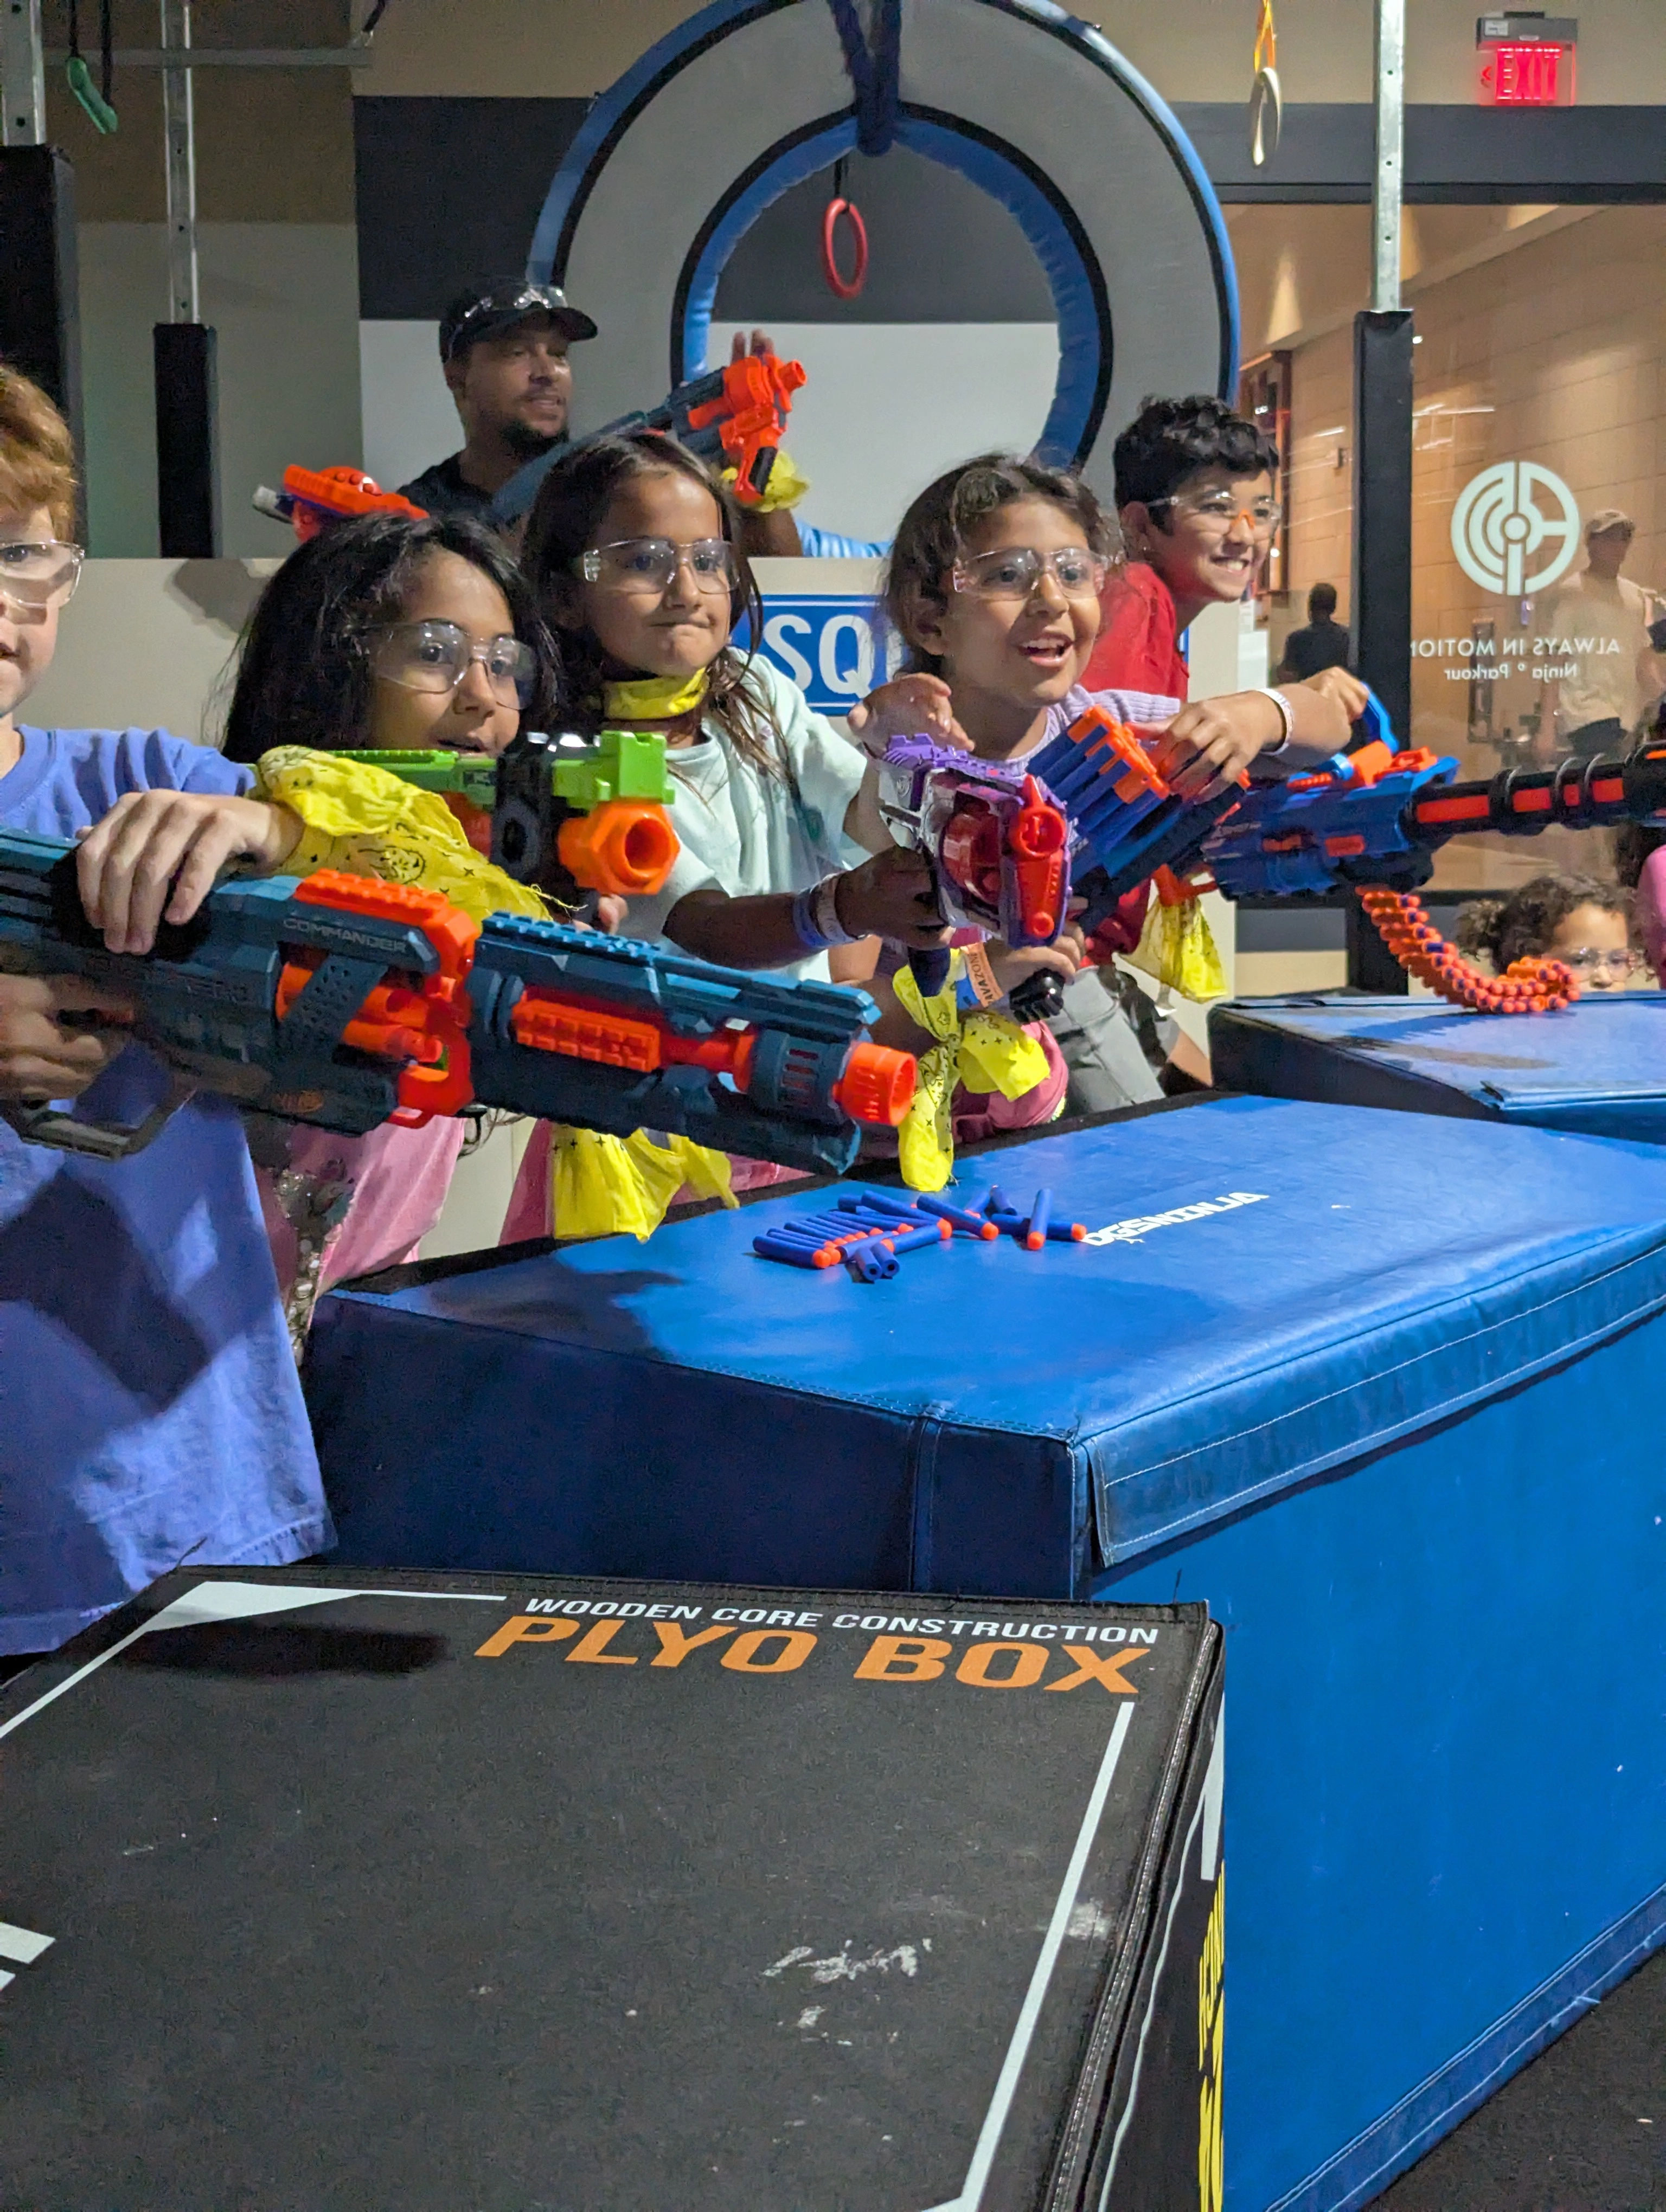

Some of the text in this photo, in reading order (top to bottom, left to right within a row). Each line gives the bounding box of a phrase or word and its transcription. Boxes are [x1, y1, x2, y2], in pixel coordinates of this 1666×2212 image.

[1495, 47, 1562, 101] EXIT
[283, 917, 406, 953] COMMANDER
[525, 1598, 1158, 1644] WOODEN CORE CONSTRUCTION
[473, 1616, 1151, 1694] PLYO BOX
